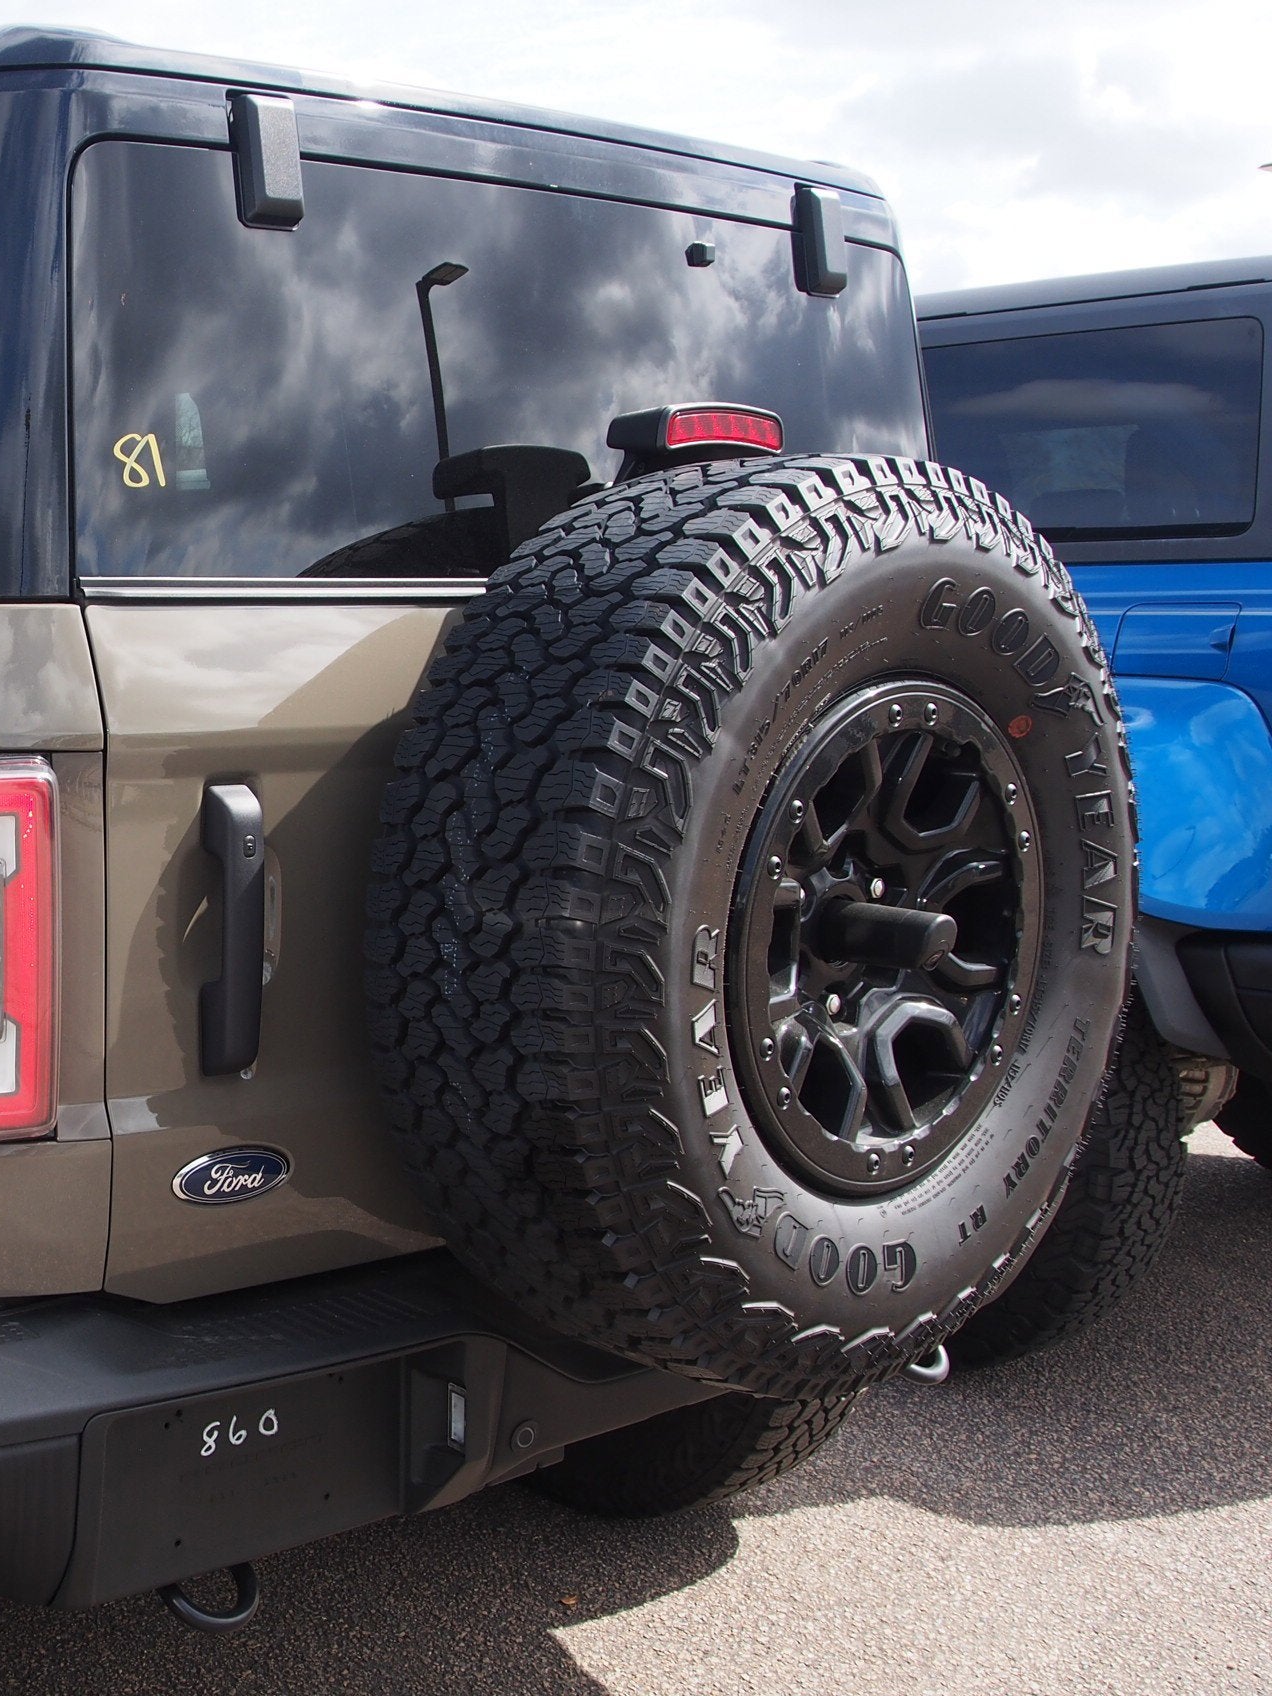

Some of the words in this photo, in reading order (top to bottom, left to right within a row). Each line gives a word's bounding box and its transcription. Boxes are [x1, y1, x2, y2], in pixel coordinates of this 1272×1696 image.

[919, 577, 1118, 956] GOODYEAR
[691, 924, 918, 1296] GOODYEAR
[1002, 1016, 1093, 1200] TERRITORY
[203, 1160, 265, 1195] Ford
[957, 1205, 989, 1247] RT
[200, 1409, 279, 1457] 860
